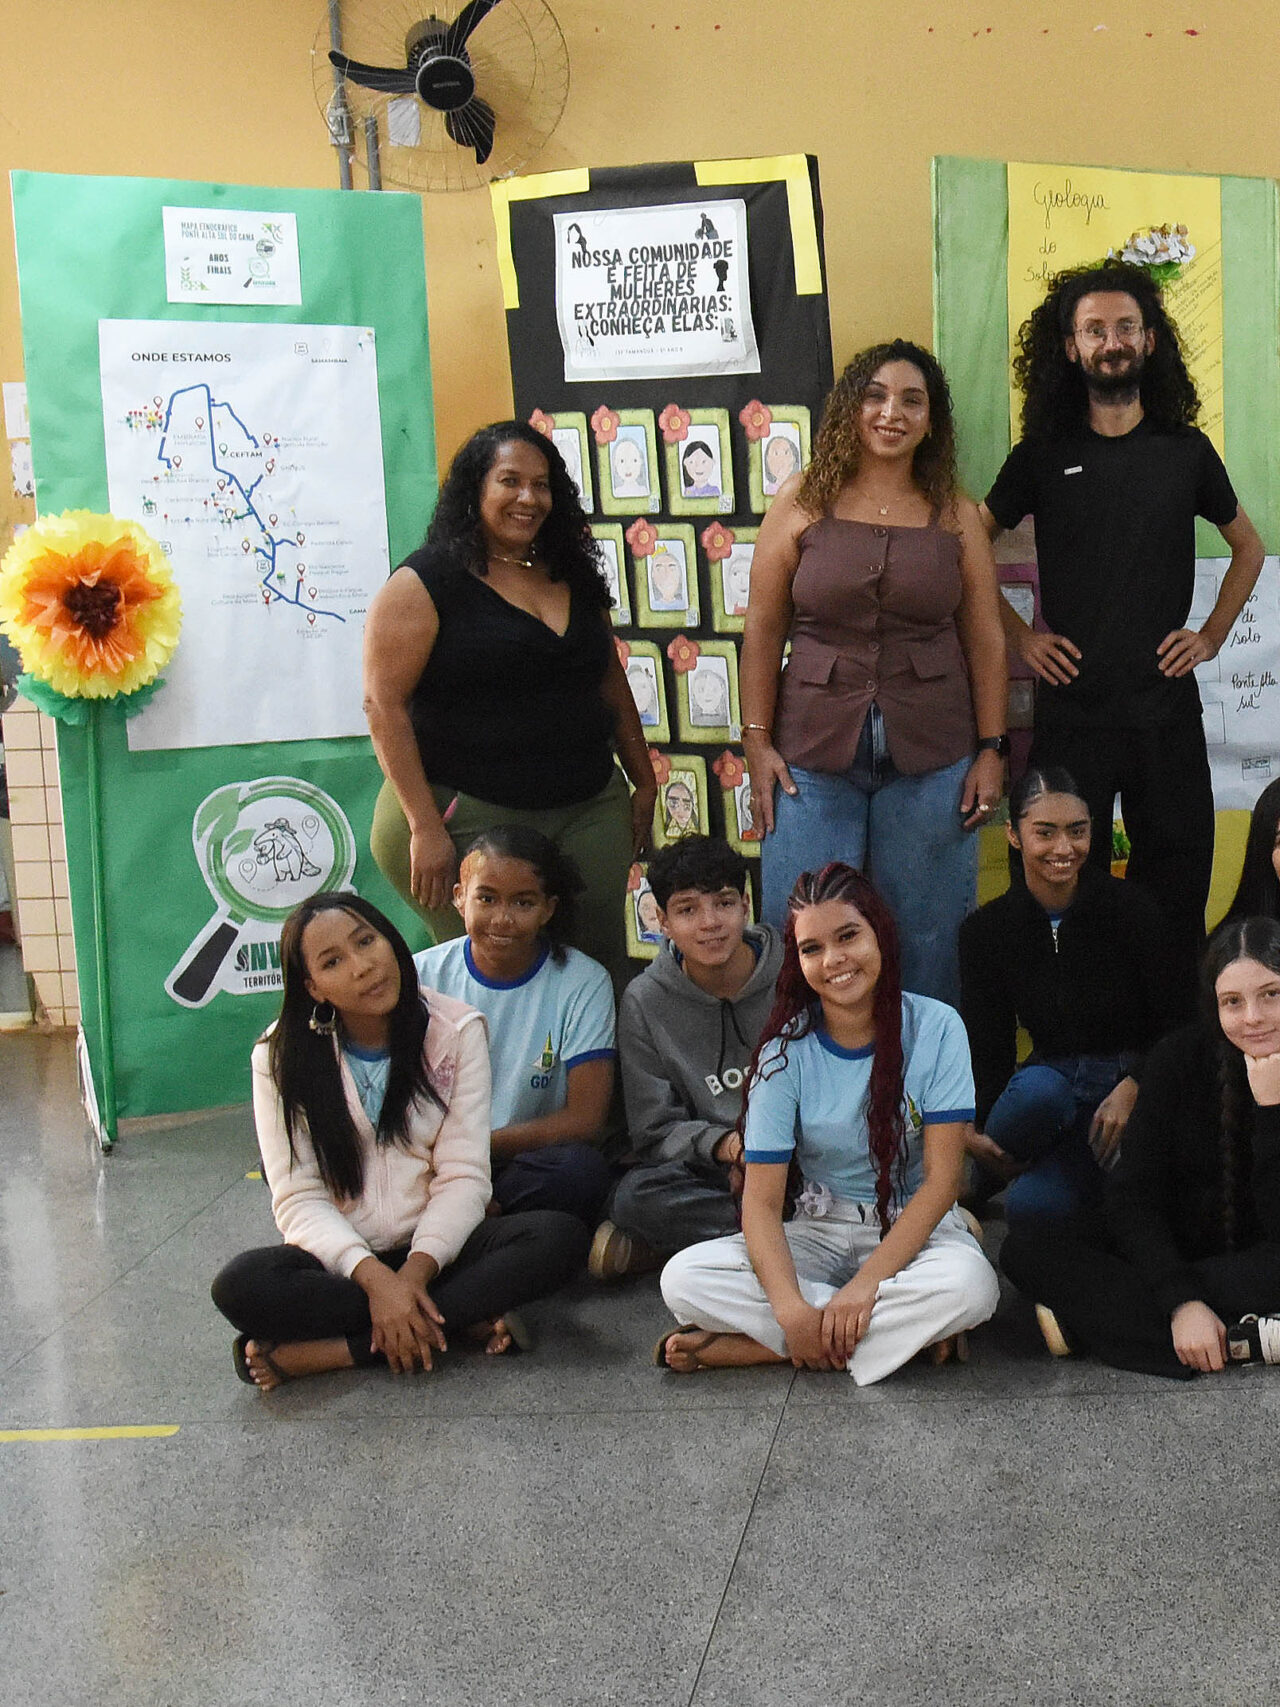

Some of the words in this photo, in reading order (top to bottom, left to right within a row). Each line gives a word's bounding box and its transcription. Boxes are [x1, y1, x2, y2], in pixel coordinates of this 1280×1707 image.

[1039, 237, 1057, 254] do
[209, 253, 229, 262] ANOS
[572, 248, 623, 269] NOSSA
[628, 240, 733, 265] COMUNIDADE
[207, 265, 232, 275] FINAIS
[624, 263, 670, 284] FEITA
[677, 261, 698, 279] DE
[610, 279, 695, 301] MULHERES
[590, 317, 666, 338] CONHEÇA
[672, 314, 719, 333] ELAS:
[131, 352, 168, 363] ONDE
[172, 352, 231, 363] ESTAMOS
[1242, 608, 1256, 624] de
[1230, 627, 1262, 648] solo
[1232, 672, 1259, 690] Ponte
[242, 941, 281, 972] INV
[243, 972, 283, 988] TERRITÓR
[530, 1075, 552, 1089] GD
